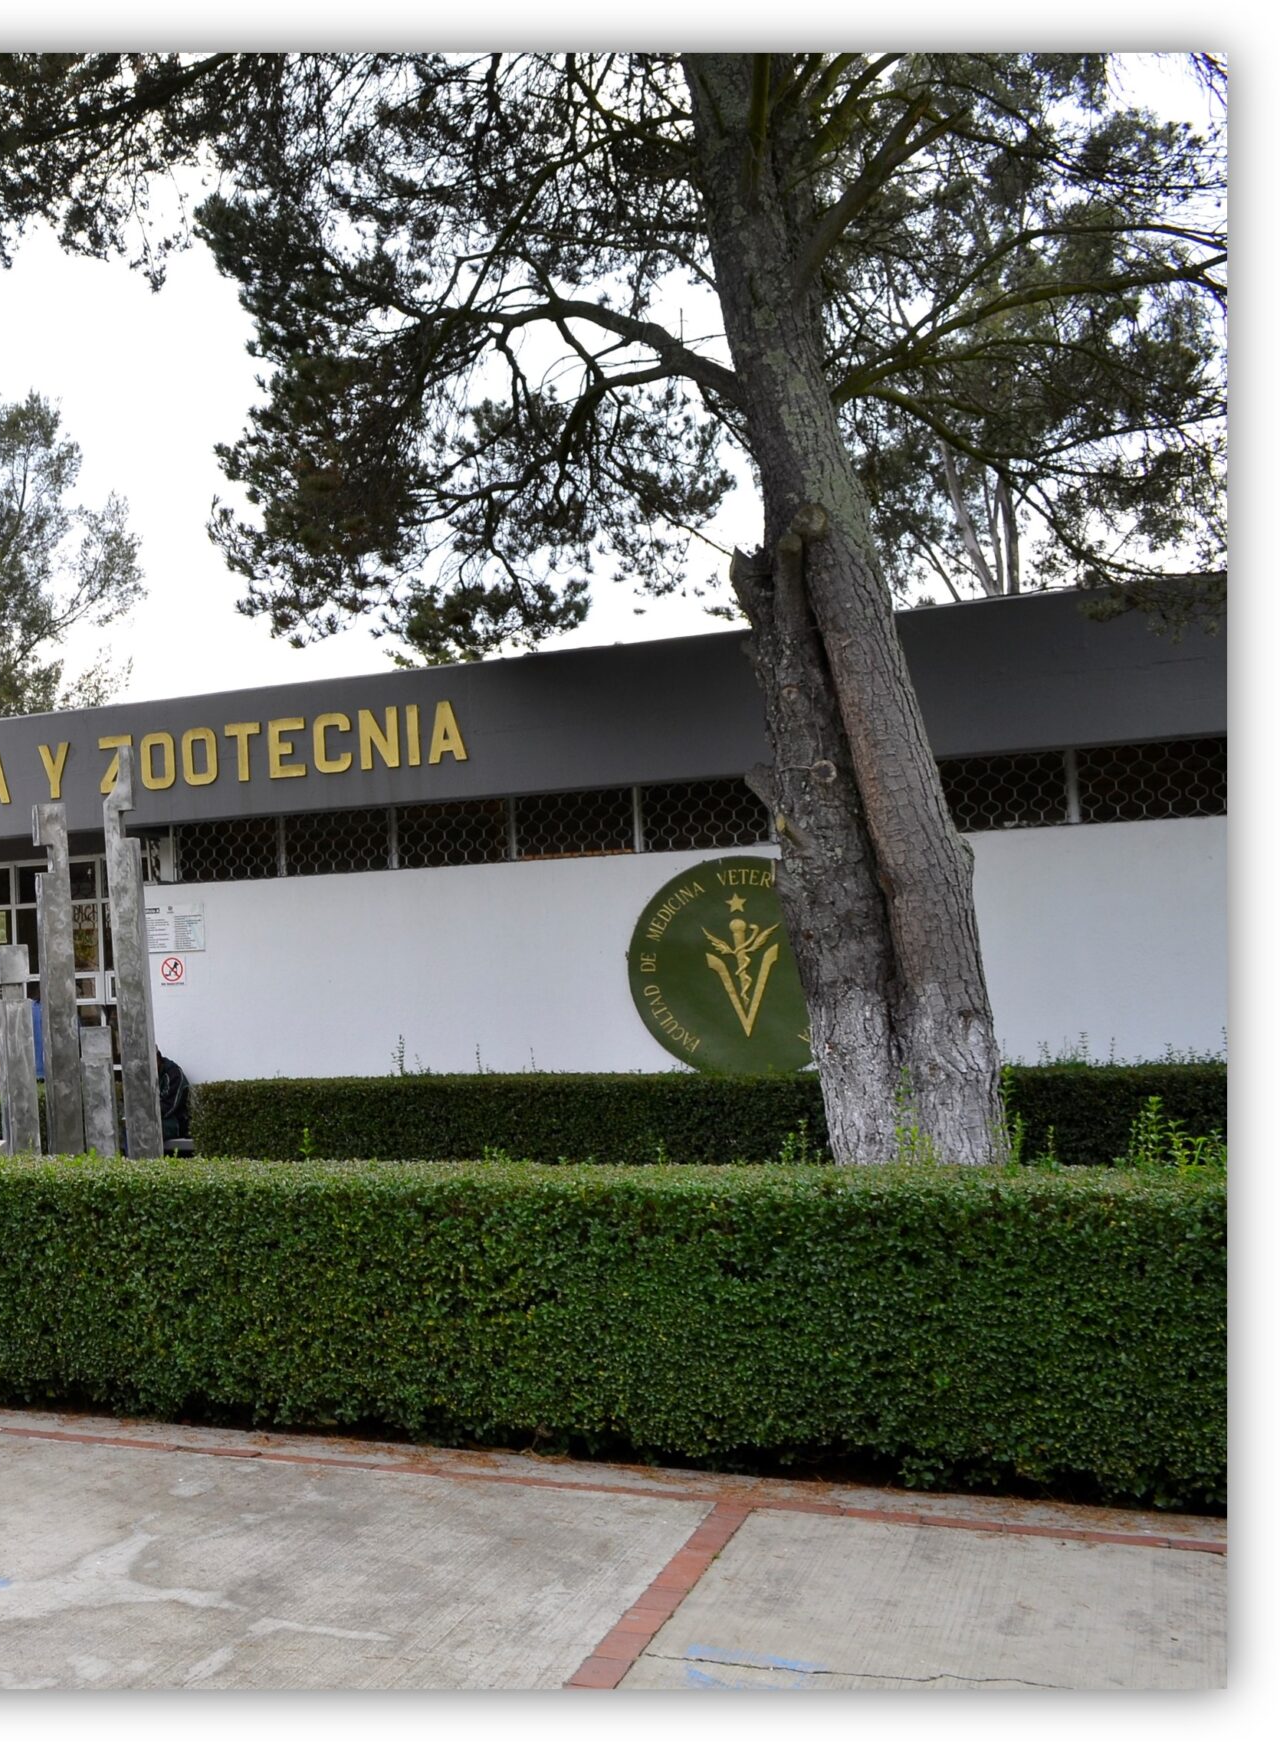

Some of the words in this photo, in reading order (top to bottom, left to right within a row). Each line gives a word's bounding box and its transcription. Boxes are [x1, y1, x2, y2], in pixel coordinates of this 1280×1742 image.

[38, 741, 70, 800] Y
[98, 701, 468, 794] ZOOTECNIA
[716, 868, 772, 889] VETER
[646, 881, 706, 942] MEDICINA
[640, 952, 657, 973] DE
[643, 985, 701, 1053] FACULTAD
